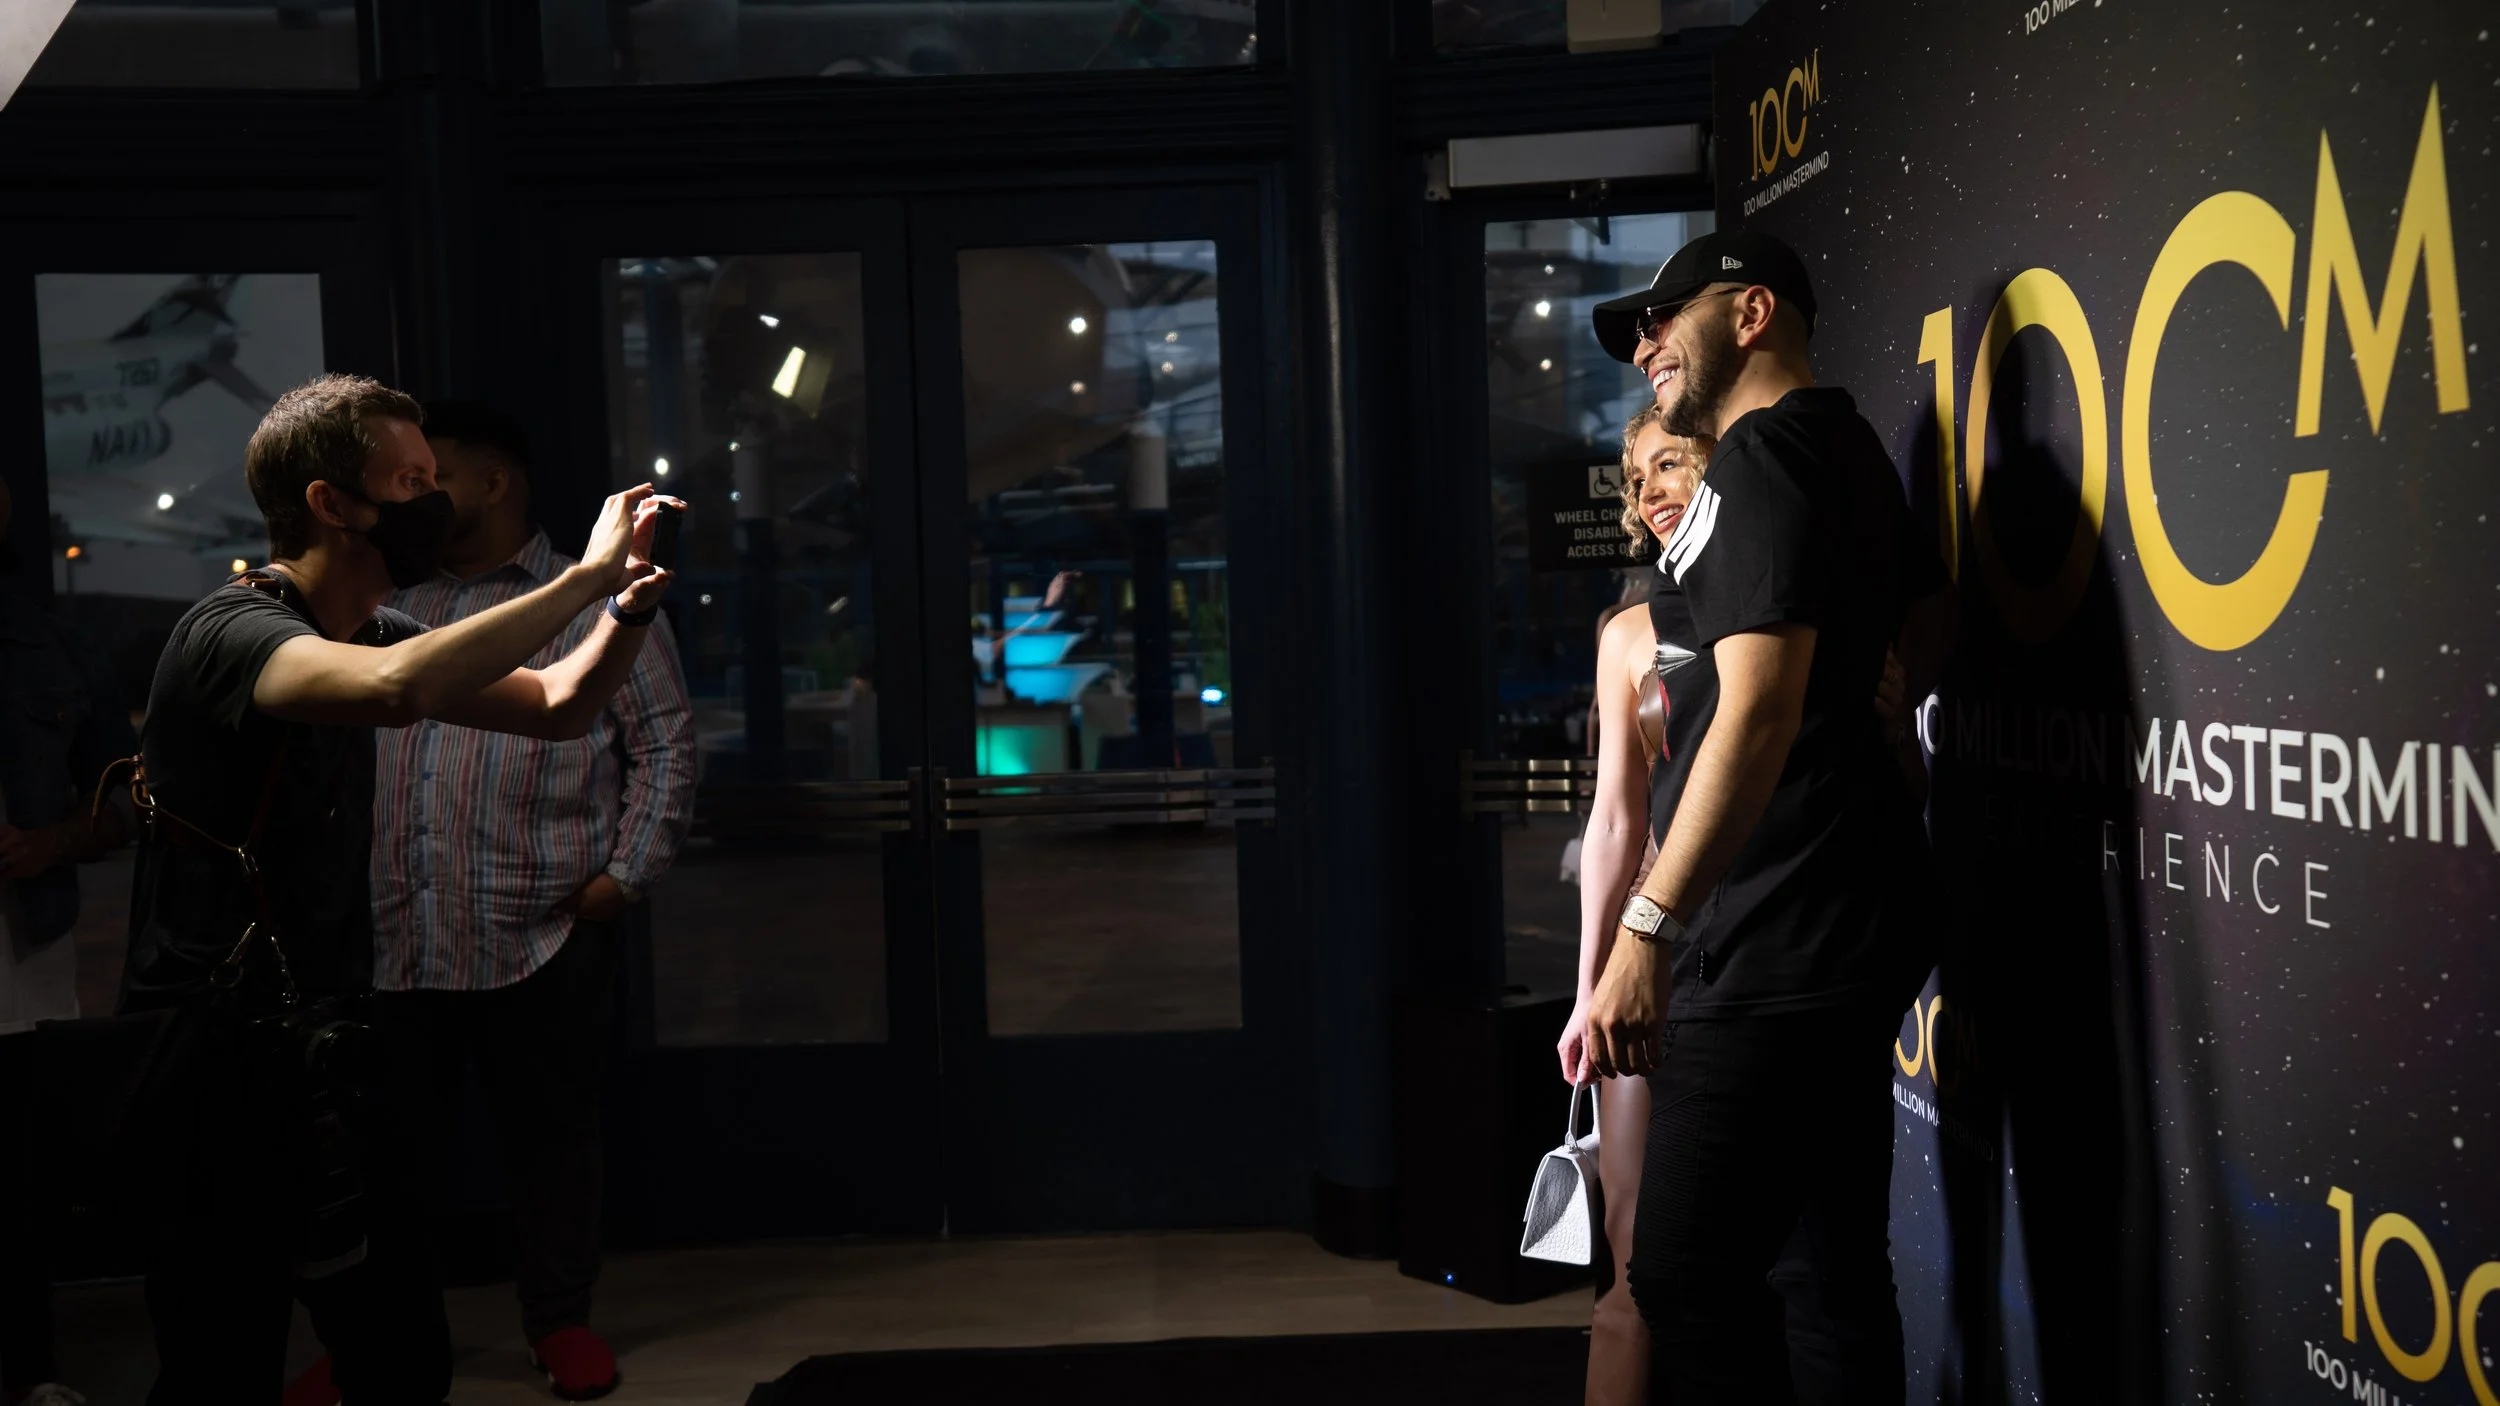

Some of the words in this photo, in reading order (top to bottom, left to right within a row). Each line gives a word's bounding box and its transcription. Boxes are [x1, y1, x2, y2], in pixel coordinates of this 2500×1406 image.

[2024, 0, 2050, 35] 100
[1744, 197, 1756, 217] 100
[1756, 179, 1783, 210] MILLION
[1783, 150, 1829, 195] MASTERMIND
[1553, 509, 1597, 525] WHEEL
[1573, 525, 1627, 540] DISABIL
[1567, 543, 1615, 559] ACCESS
[2303, 1340, 2349, 1391] 100
